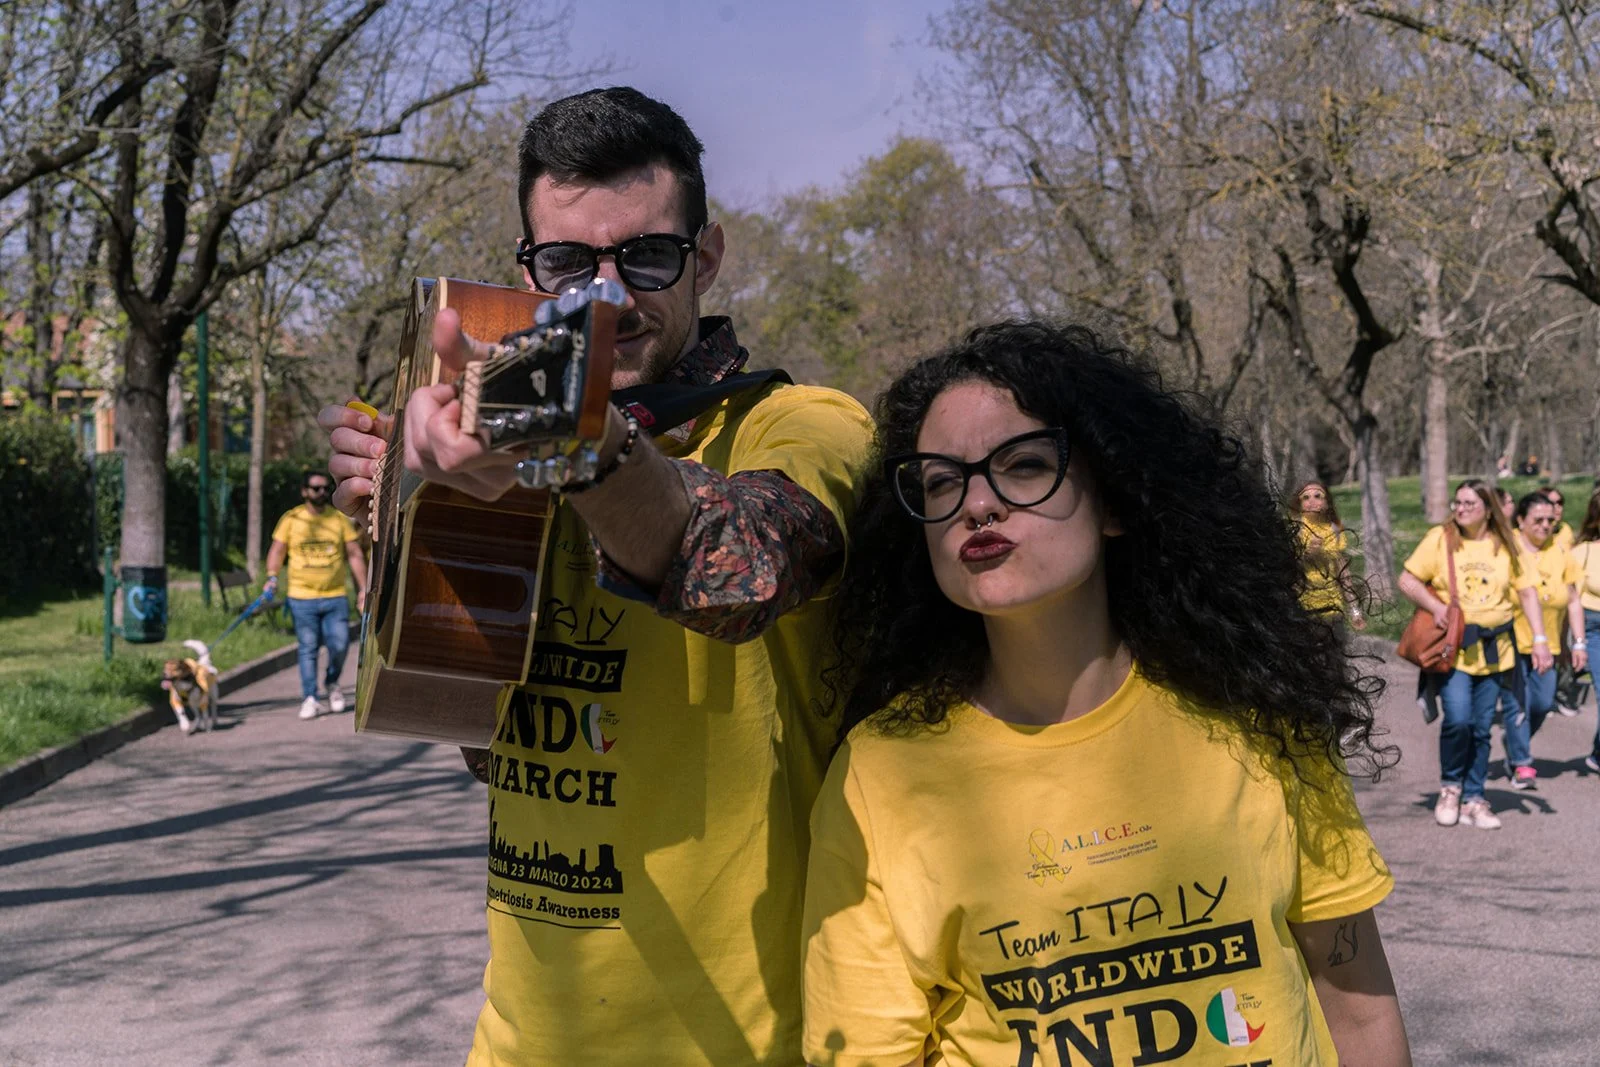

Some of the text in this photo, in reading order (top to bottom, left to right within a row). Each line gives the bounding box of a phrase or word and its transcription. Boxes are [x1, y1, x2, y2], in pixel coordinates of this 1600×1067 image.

[497, 691, 576, 752] ND
[510, 863, 525, 878] 23
[529, 867, 568, 887] MARZO
[571, 875, 613, 889] 2024
[536, 896, 620, 919] Awareness
[979, 876, 1228, 960] Team ITALY
[991, 935, 1247, 1004] WORLDWIDE
